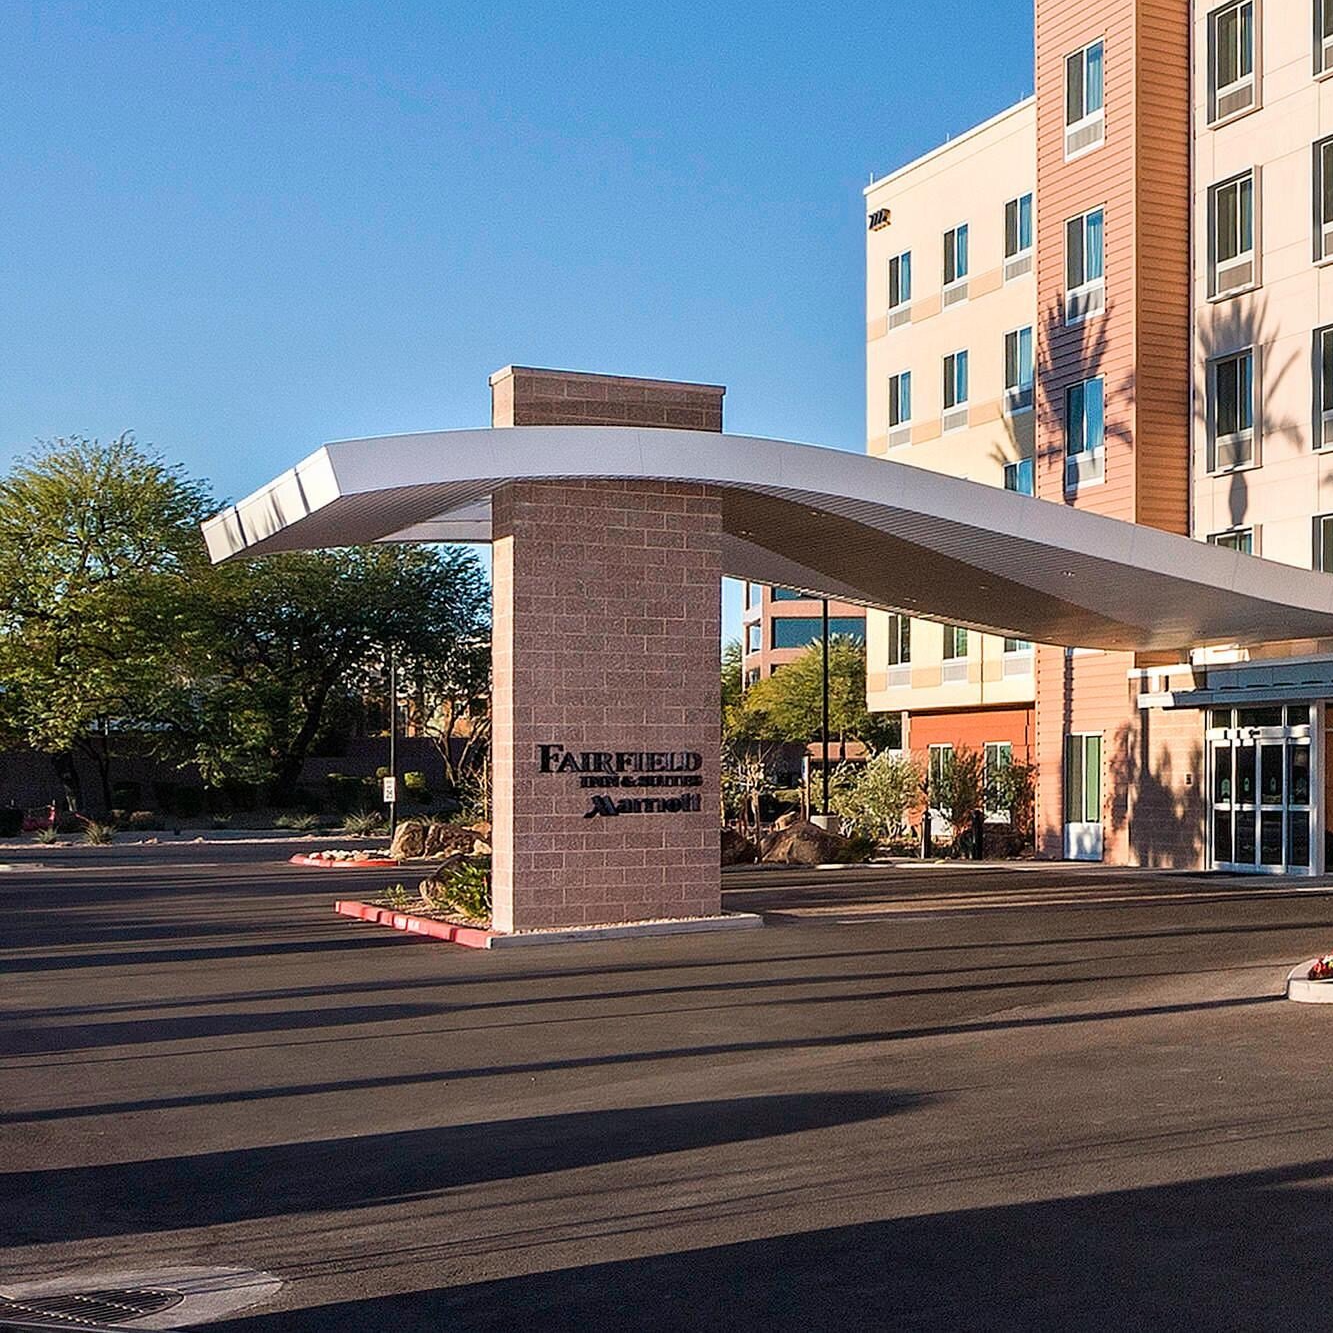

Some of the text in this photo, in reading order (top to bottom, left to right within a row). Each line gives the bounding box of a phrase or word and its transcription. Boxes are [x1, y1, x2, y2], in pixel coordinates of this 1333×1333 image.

[537, 744, 703, 775] FAIRFIELD
[579, 776, 620, 788] INN
[583, 792, 701, 818] Marriott
